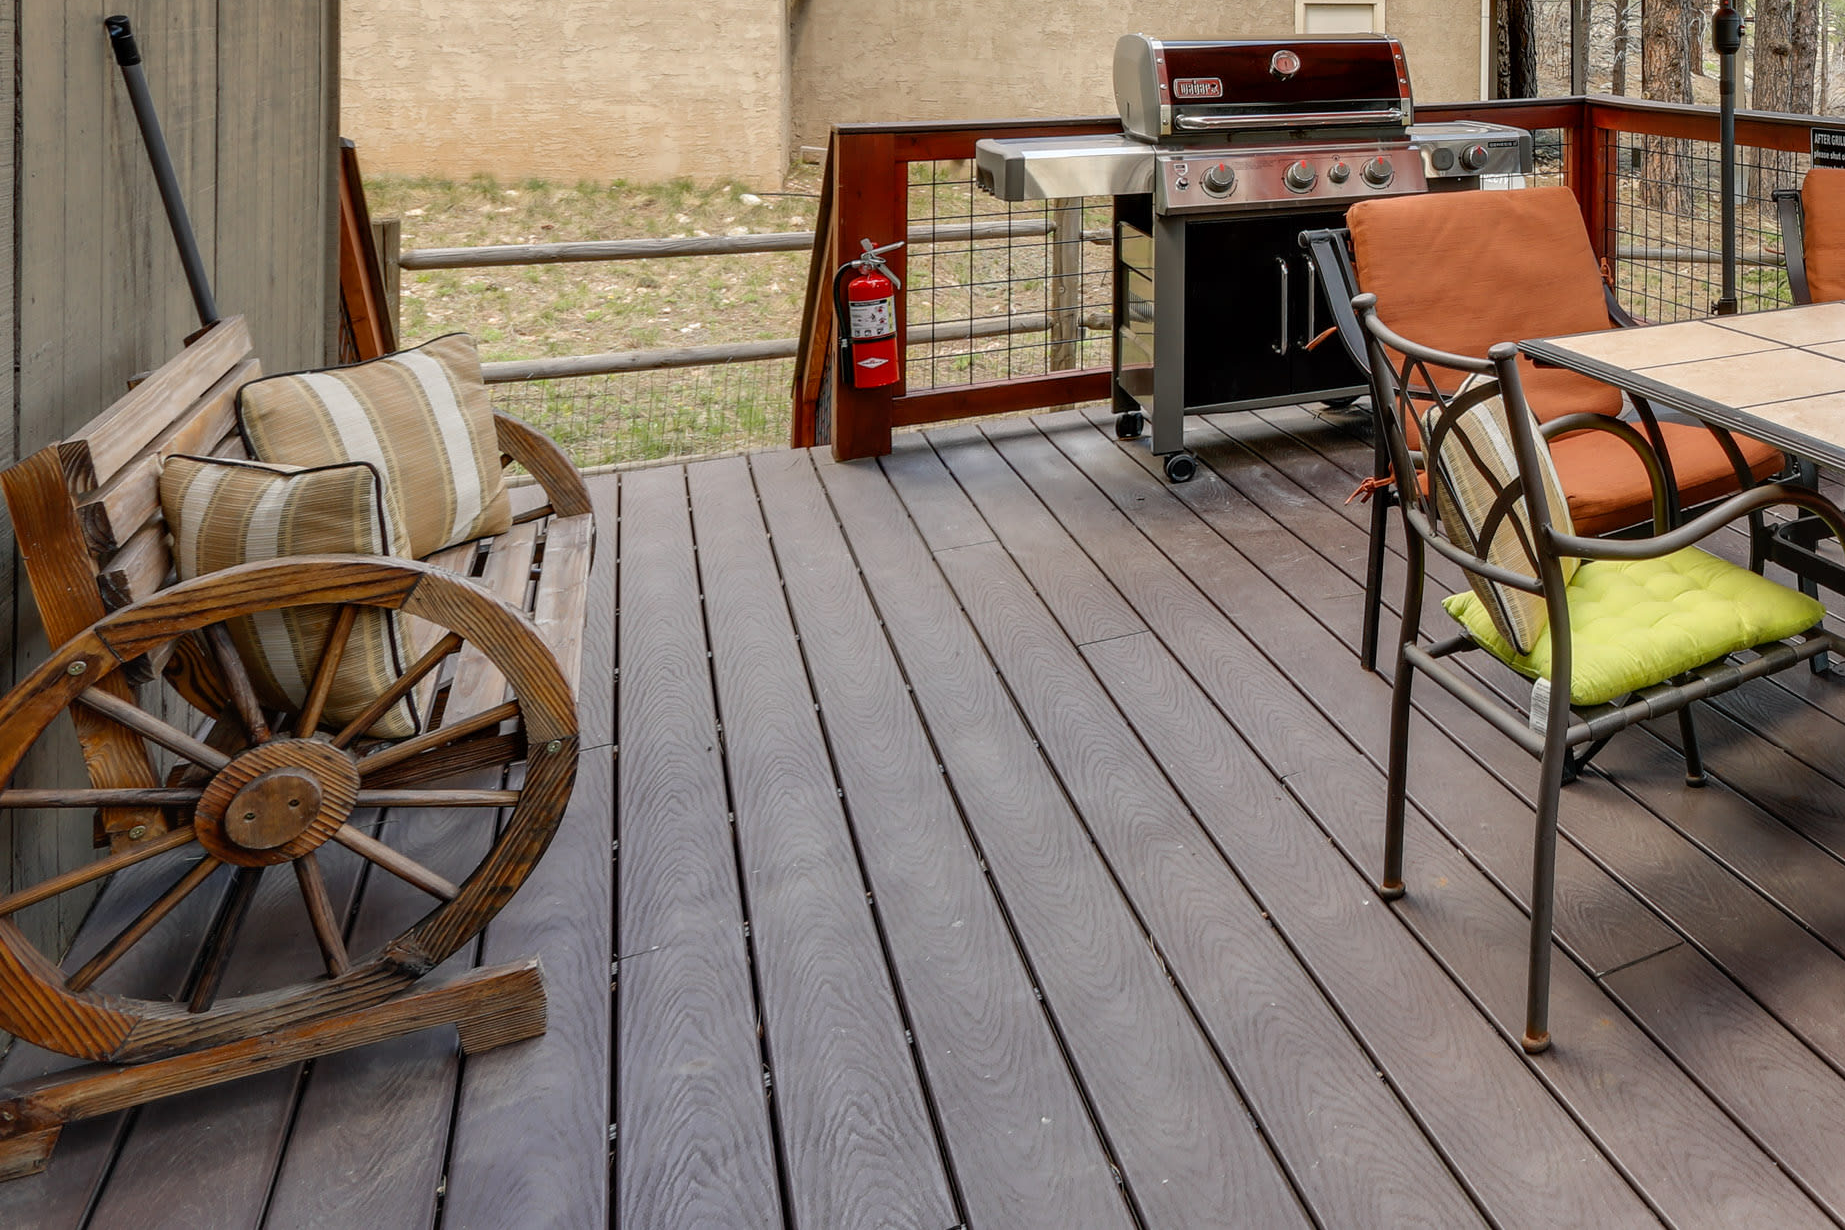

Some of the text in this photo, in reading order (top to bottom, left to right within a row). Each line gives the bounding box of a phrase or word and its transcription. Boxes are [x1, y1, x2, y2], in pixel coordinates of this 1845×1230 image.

[1814, 133, 1831, 145] AFTER
[1814, 149, 1830, 159] please
[1830, 151, 1841, 161] shut
